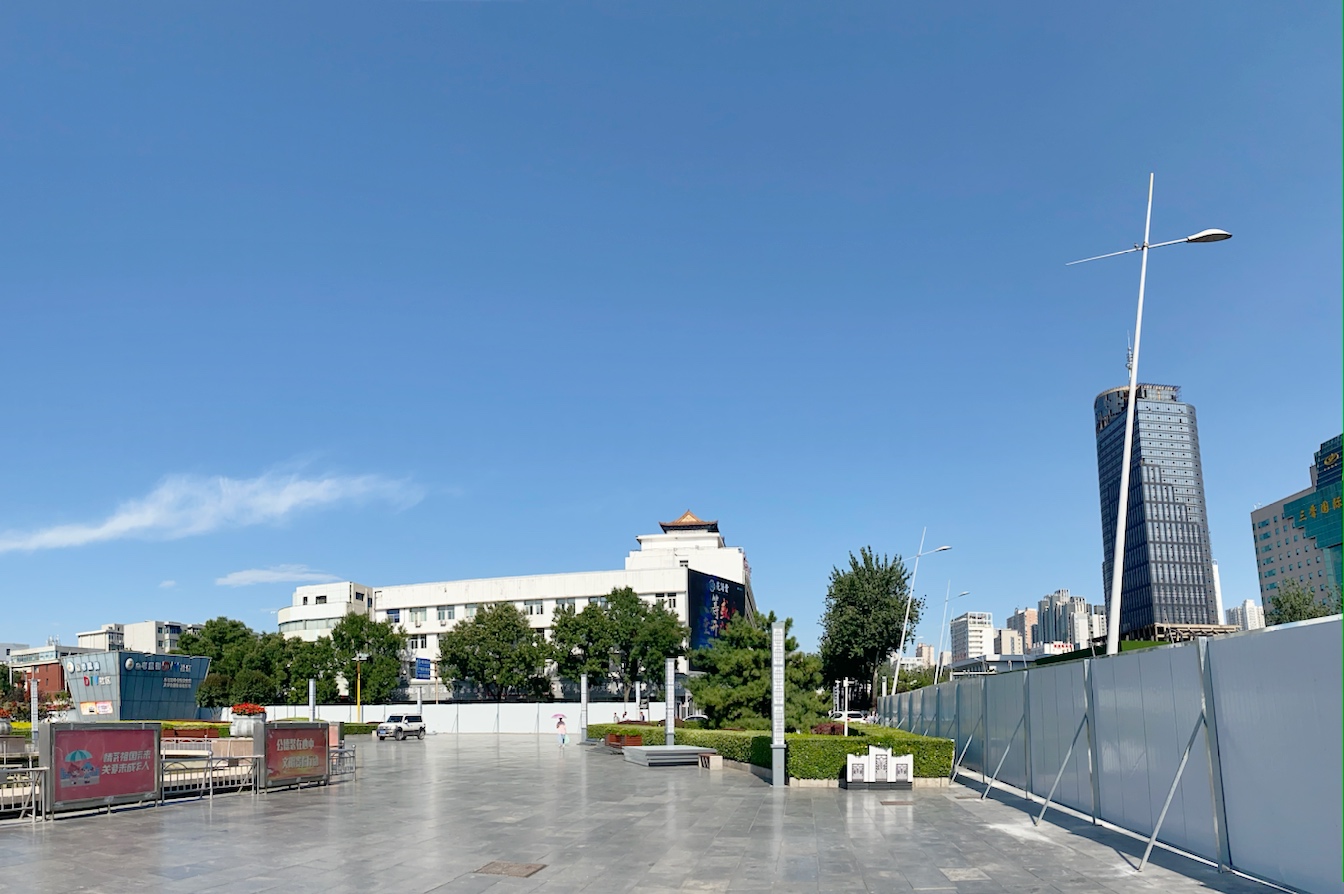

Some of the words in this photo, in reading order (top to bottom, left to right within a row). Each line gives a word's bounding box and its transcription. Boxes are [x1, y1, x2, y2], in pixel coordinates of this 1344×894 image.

[101, 761, 150, 775] 关爱未成年人
